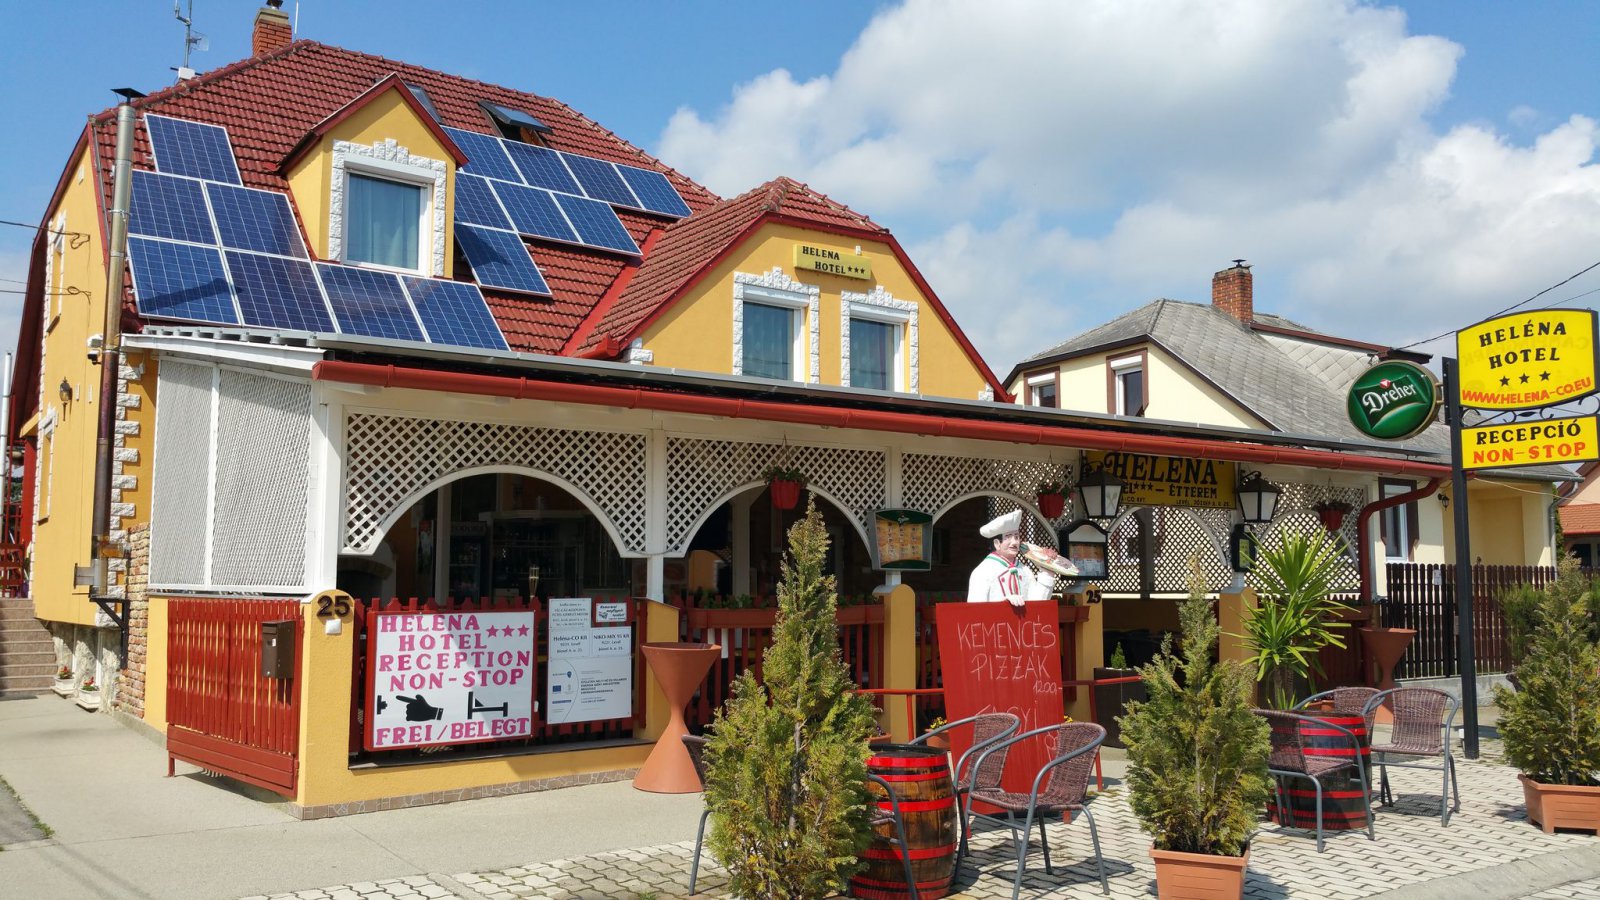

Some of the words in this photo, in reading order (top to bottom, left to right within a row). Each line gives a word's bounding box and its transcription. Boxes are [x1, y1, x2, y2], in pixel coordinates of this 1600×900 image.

[802, 246, 840, 261] HELENA
[815, 261, 846, 274] HOTEL
[1479, 320, 1566, 347] HELÉNA
[1488, 347, 1560, 369] HOTEL
[1362, 382, 1417, 415] Dreher
[1473, 442, 1586, 464] NON-STOP
[1168, 484, 1217, 499] ÉTTEREM
[317, 595, 350, 618] 25
[1085, 590, 1101, 604] 25
[380, 615, 480, 633] HELENA
[957, 615, 1056, 650] KEMENCÉS
[398, 633, 487, 652] HOTEL
[379, 650, 530, 672] RECEPTION
[970, 652, 1050, 681] PIZZÁK
[390, 668, 524, 692] NON-STOP
